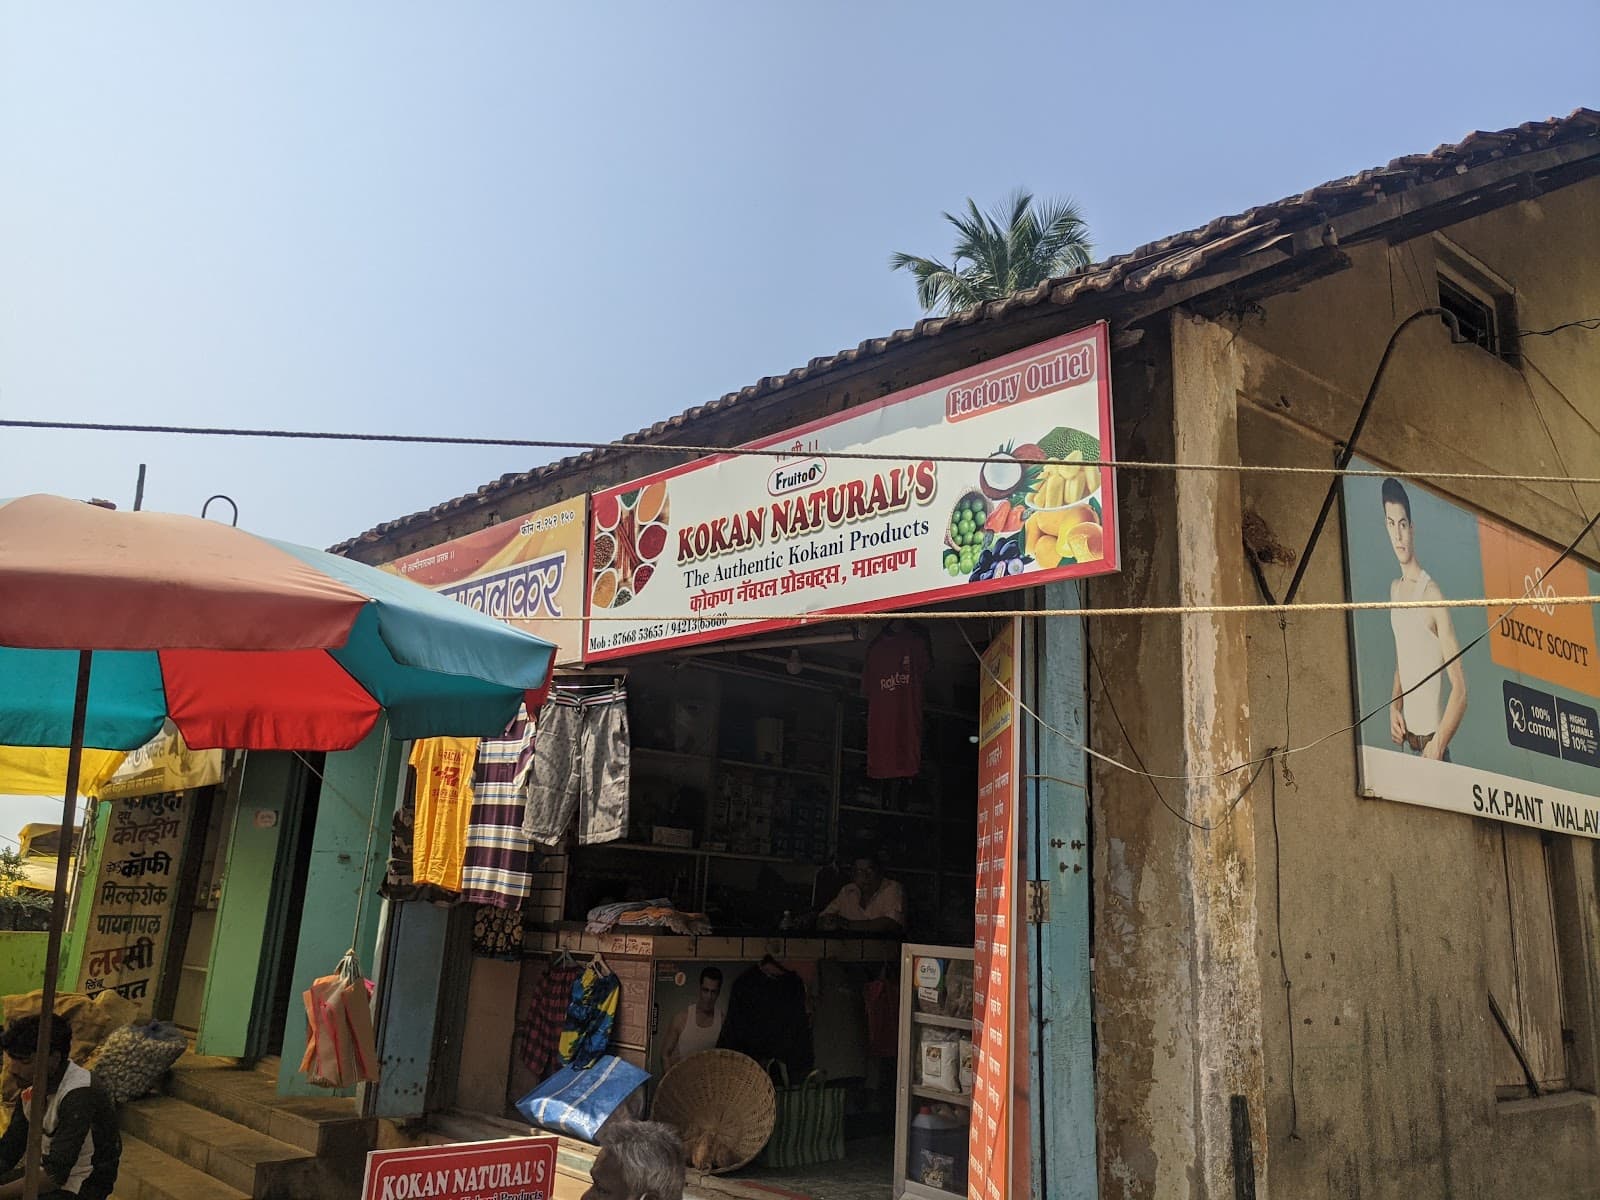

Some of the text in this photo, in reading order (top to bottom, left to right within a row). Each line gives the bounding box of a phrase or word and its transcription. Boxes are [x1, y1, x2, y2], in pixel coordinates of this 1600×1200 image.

[950, 346, 1089, 417] Factory Outlet
[677, 460, 936, 562] KOKAN NATURAL'S
[684, 519, 929, 588] The Authentic Kokani Products
[690, 587, 735, 612] कोकण
[851, 548, 917, 578] मालवण
[612, 628, 636, 646] 87668
[638, 624, 663, 642] 53655
[671, 619, 697, 636] 94213
[1499, 614, 1588, 667] DIXCY SCOTT
[1530, 705, 1551, 722] 100%
[1568, 713, 1588, 726] HIGHLY
[1527, 721, 1557, 740] COTTON
[1570, 724, 1595, 738] DURABLE
[1571, 736, 1588, 752] 10%
[1472, 784, 1544, 824] S.K.PANT
[121, 851, 173, 878] कॉफी
[101, 881, 168, 906] मिल्कशेक
[89, 936, 155, 977] लस्सी
[381, 1159, 546, 1200] KOKAN NATURAL'S
